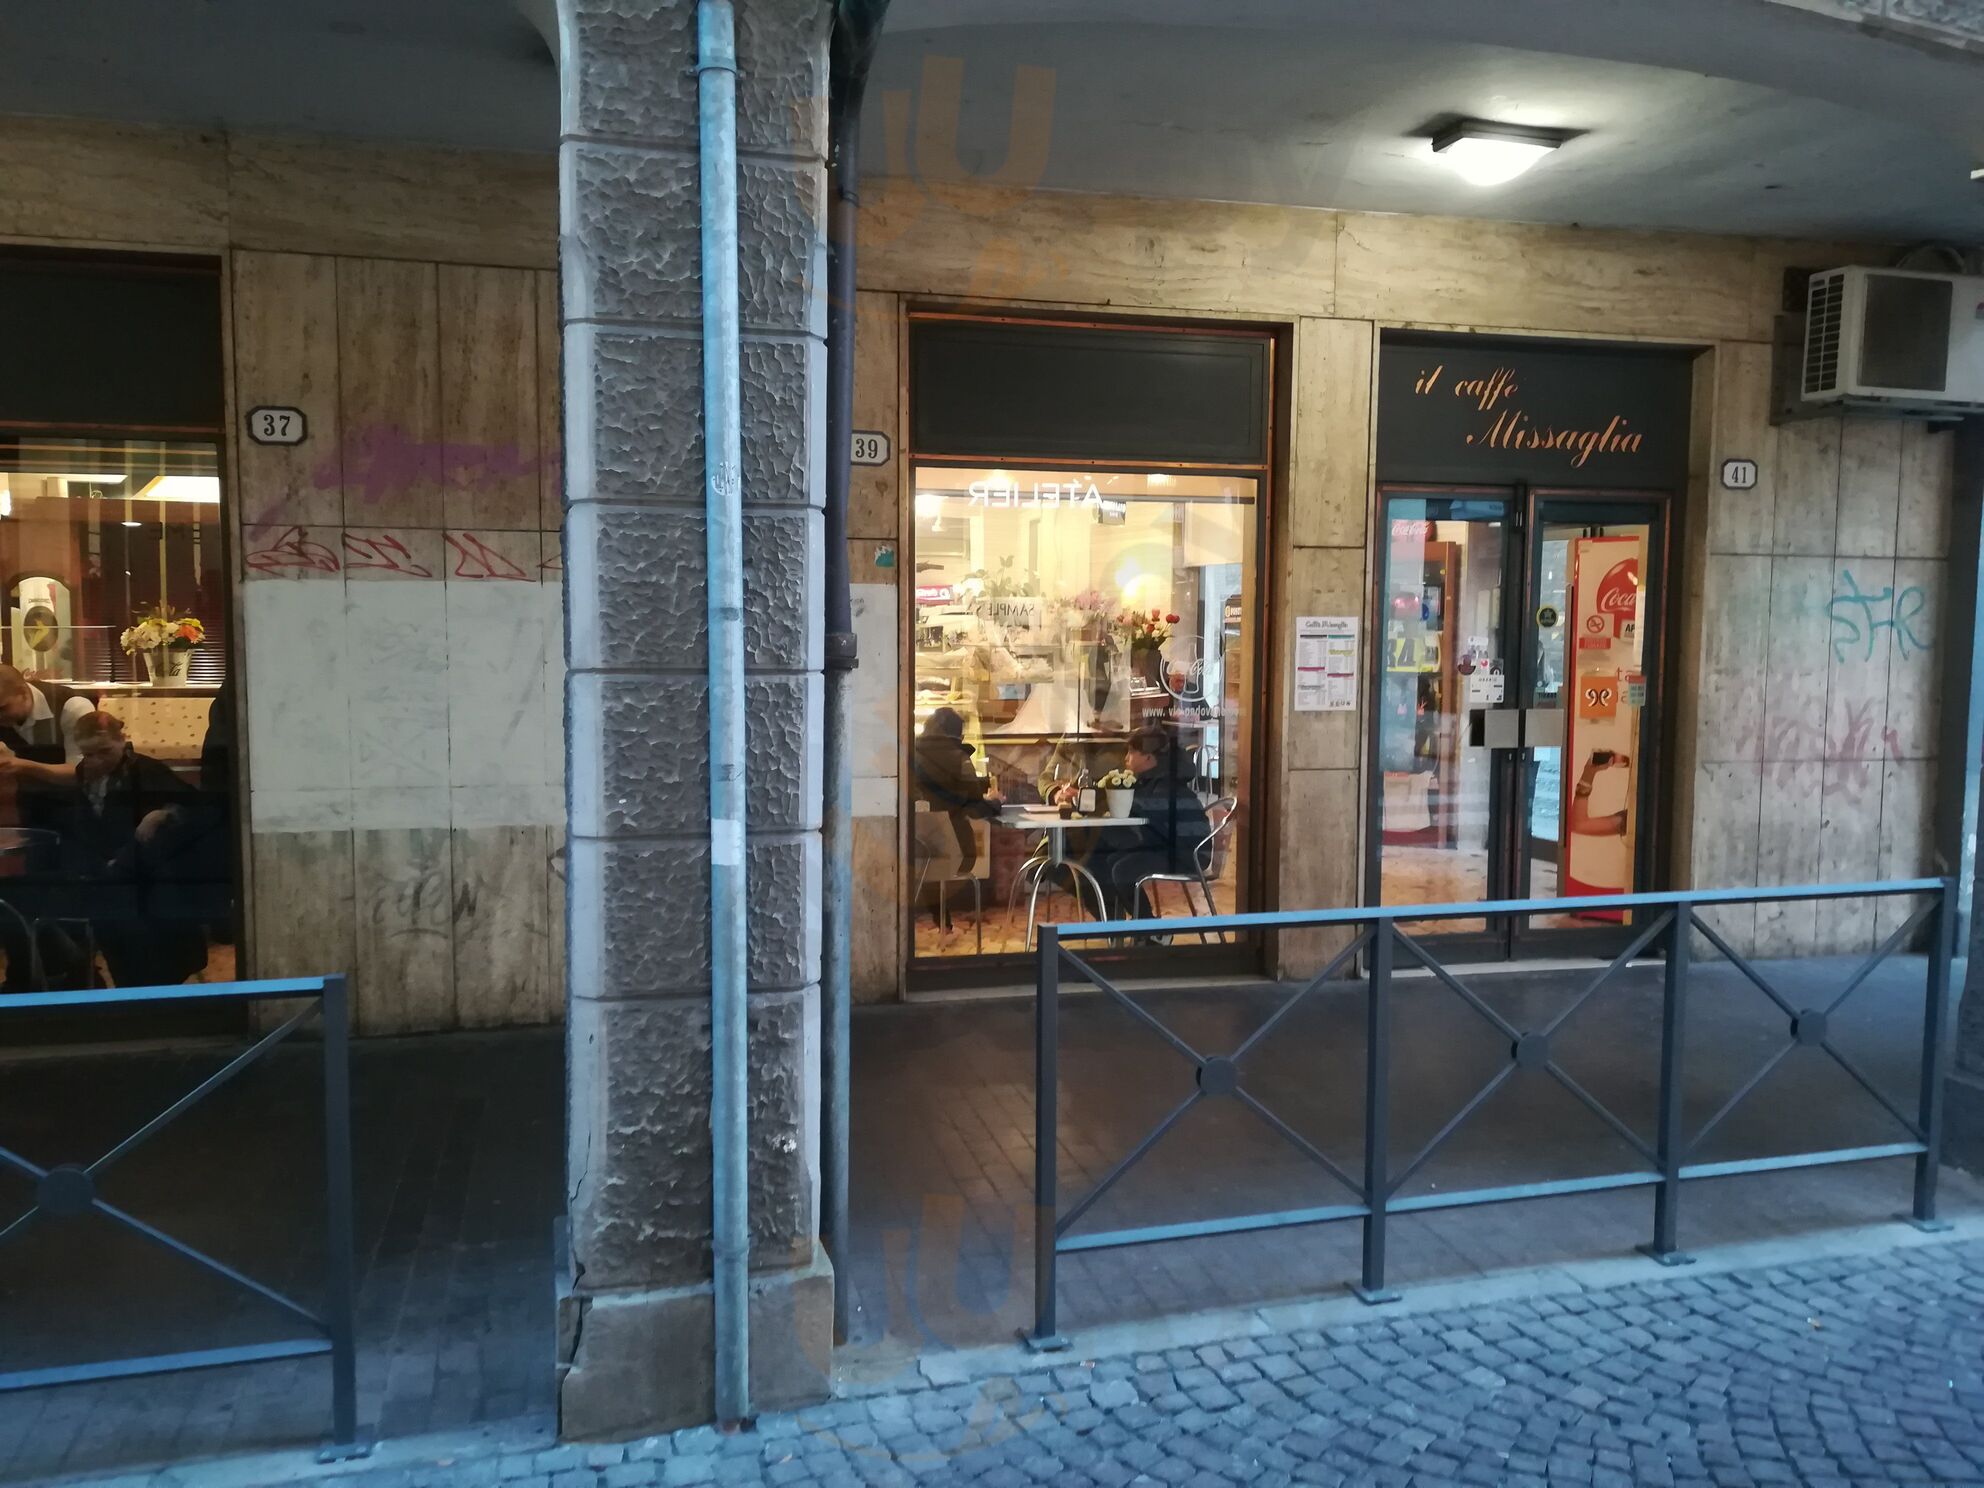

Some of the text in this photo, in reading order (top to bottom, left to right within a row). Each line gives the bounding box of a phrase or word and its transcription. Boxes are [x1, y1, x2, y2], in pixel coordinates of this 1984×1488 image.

[1415, 365, 1443, 395] il
[263, 414, 291, 437] 37
[856, 439, 878, 459] 39
[1466, 409, 1642, 468] Missaglia
[1732, 466, 1747, 484] 41
